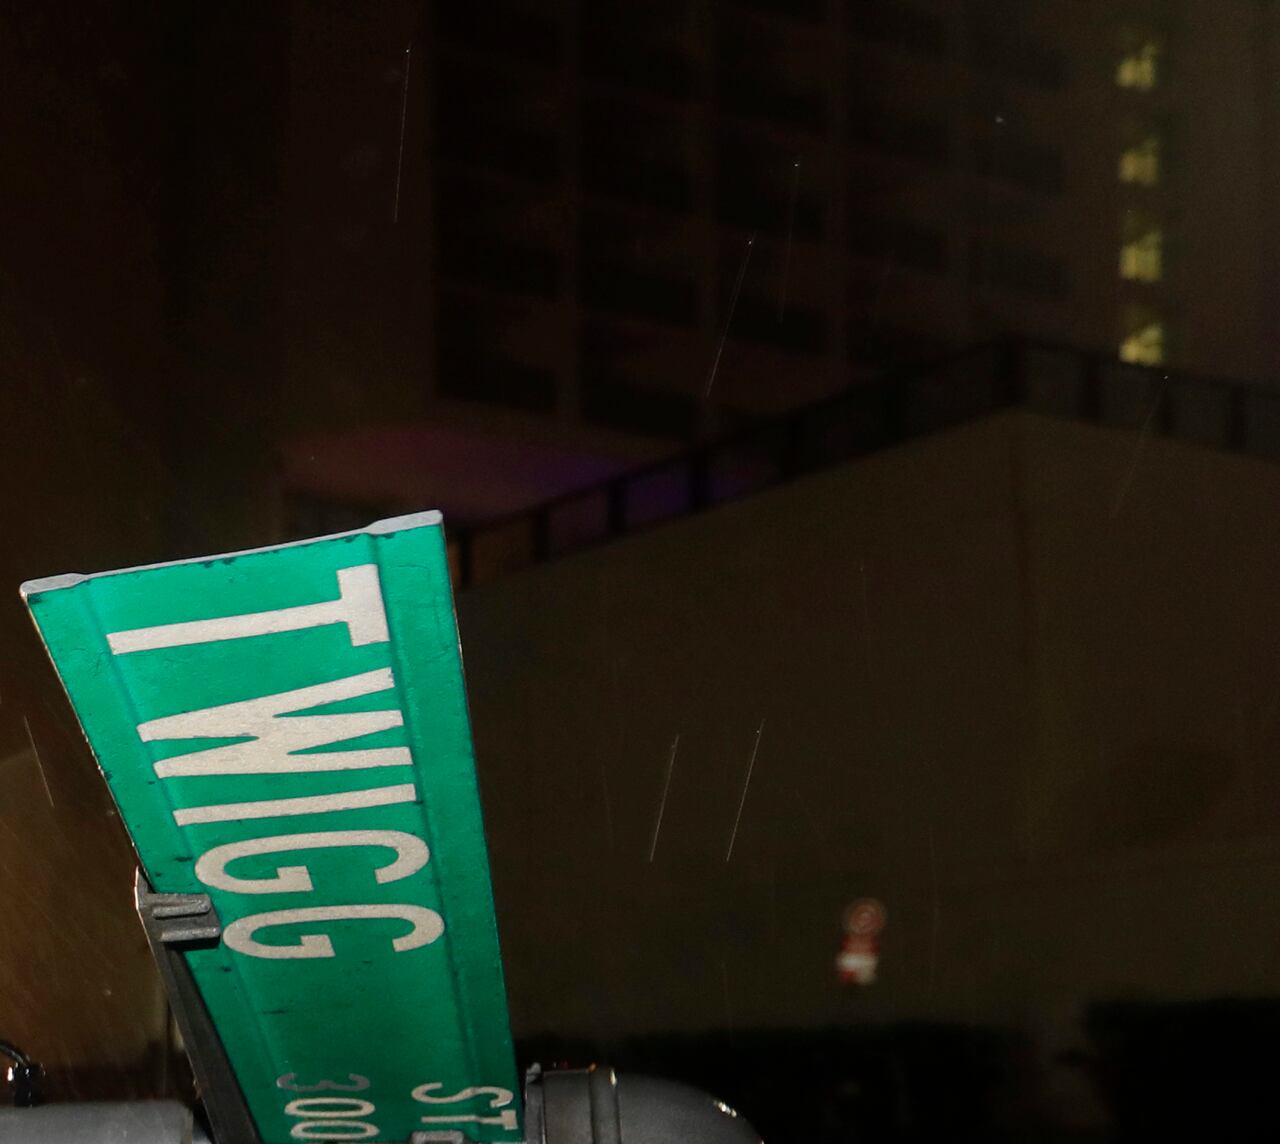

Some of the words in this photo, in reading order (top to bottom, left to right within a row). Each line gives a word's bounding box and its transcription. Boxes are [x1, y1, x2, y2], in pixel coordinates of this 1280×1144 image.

[105, 562, 446, 960] TWIGG
[276, 1071, 380, 1140] 300
[411, 1081, 518, 1131] ST
